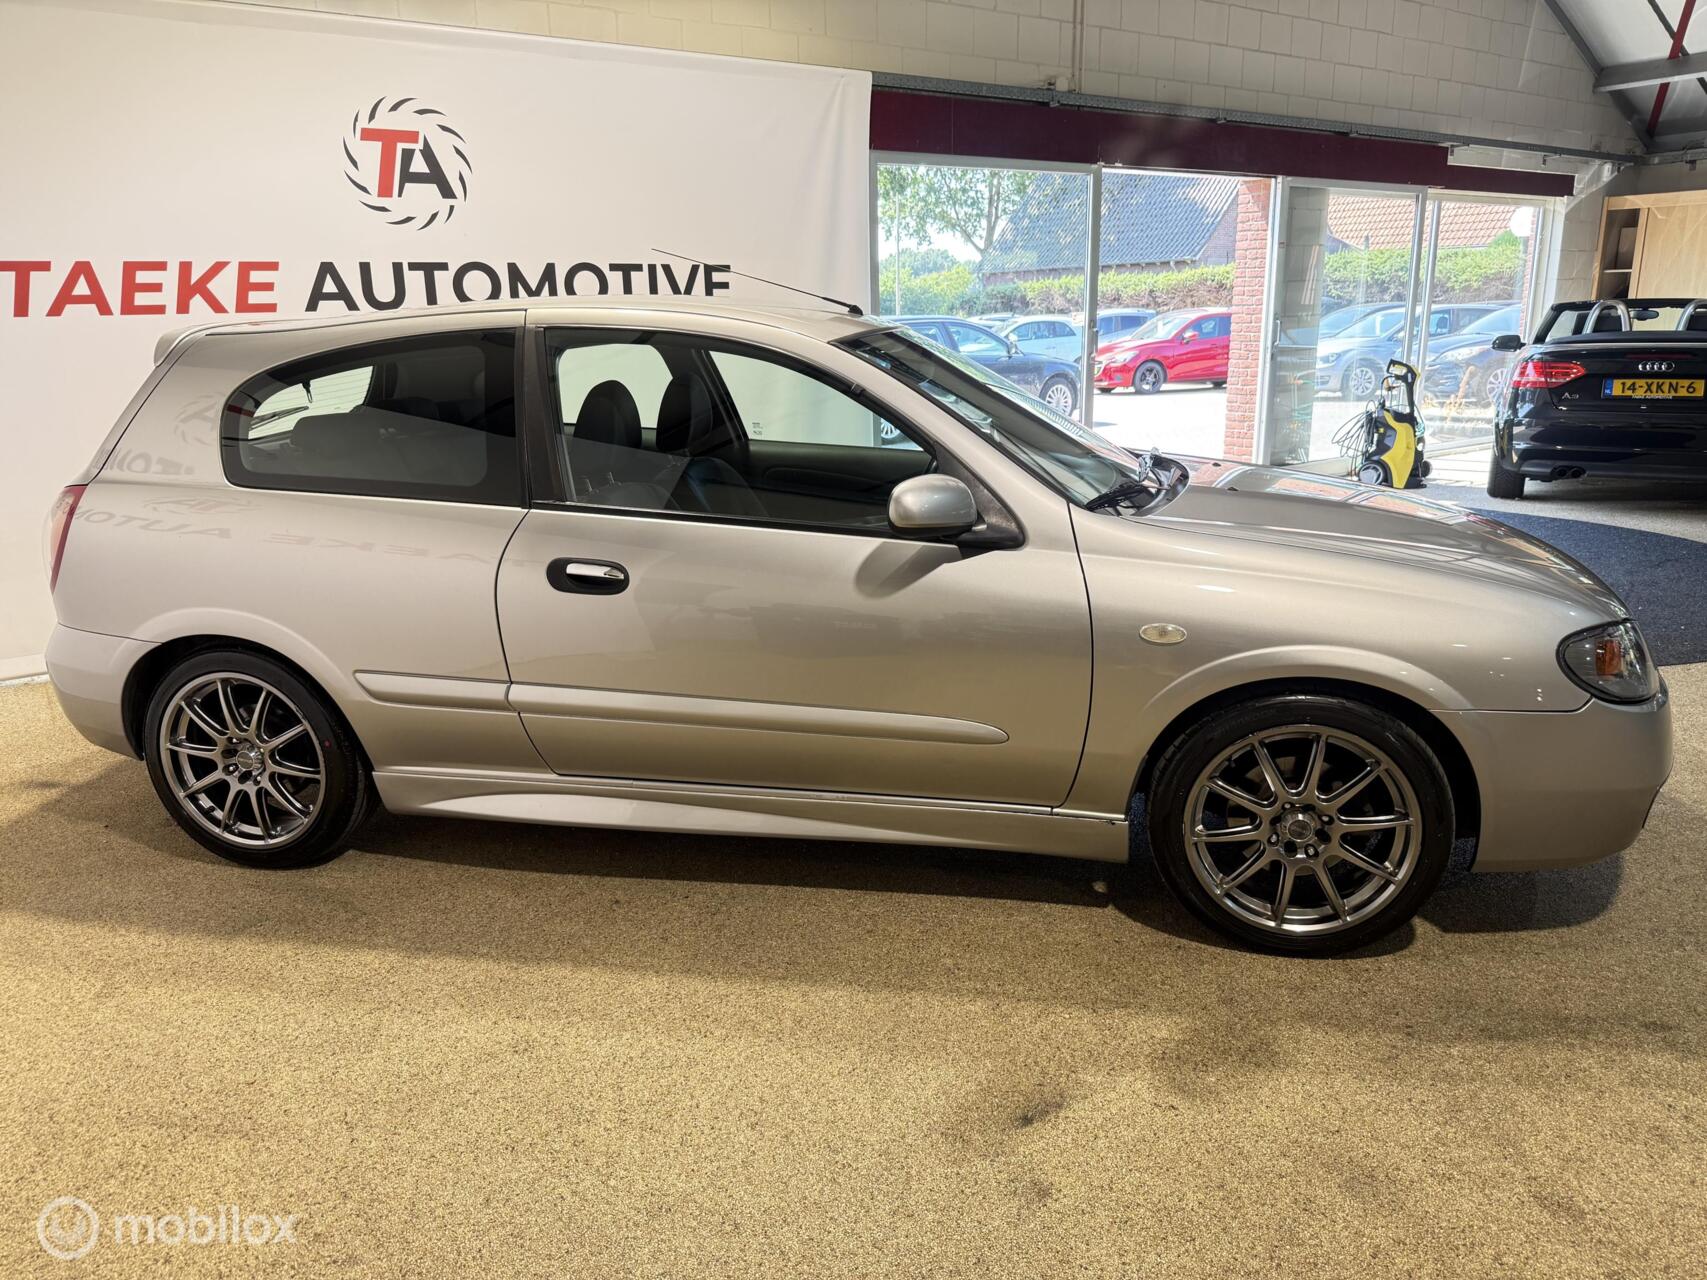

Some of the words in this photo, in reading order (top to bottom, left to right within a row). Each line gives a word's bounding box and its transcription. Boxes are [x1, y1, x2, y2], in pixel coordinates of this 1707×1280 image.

[360, 127, 458, 200] TA
[0, 260, 280, 318] TAEKE
[304, 261, 731, 312] AUTOMOTIVE
[1620, 381, 1697, 394] 14-XKN-6
